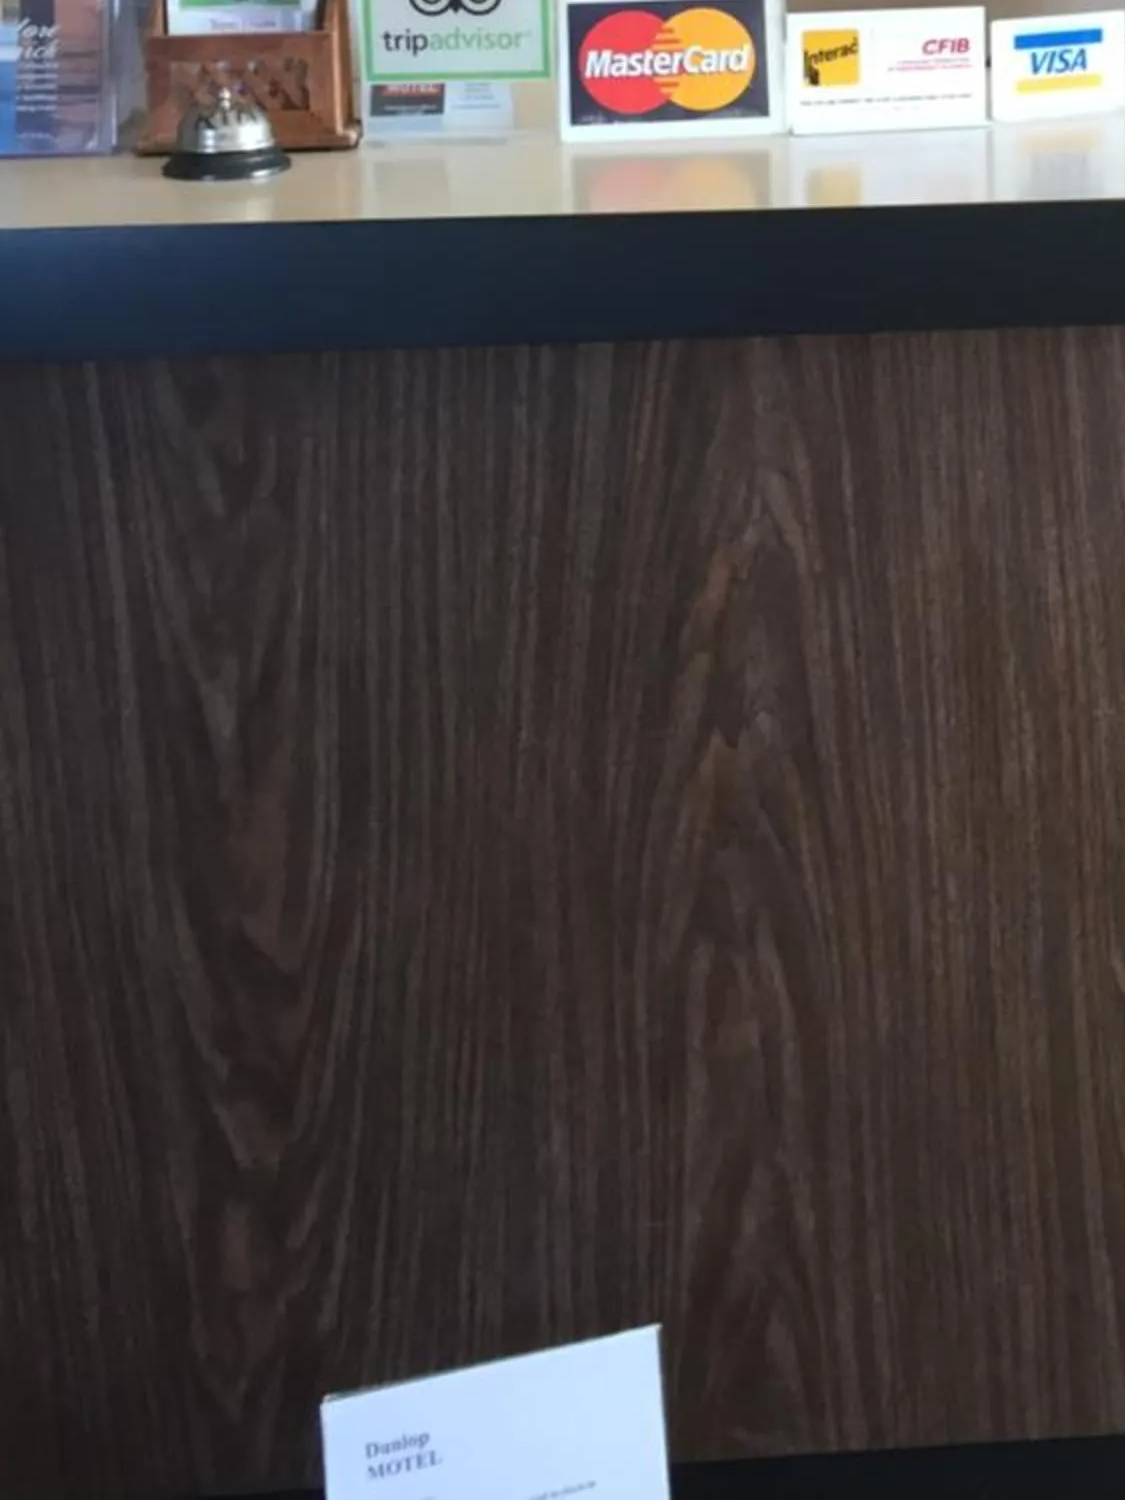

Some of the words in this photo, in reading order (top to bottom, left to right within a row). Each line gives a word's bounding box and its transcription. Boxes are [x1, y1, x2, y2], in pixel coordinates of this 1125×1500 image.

[381, 29, 526, 57] tripadvisor
[803, 37, 858, 68] Interac
[922, 37, 971, 55] CFIB
[583, 41, 752, 79] MasterCard
[1030, 47, 1088, 75] VISA
[365, 1431, 430, 1460] Dunlop
[366, 1449, 444, 1480] MOTEL
